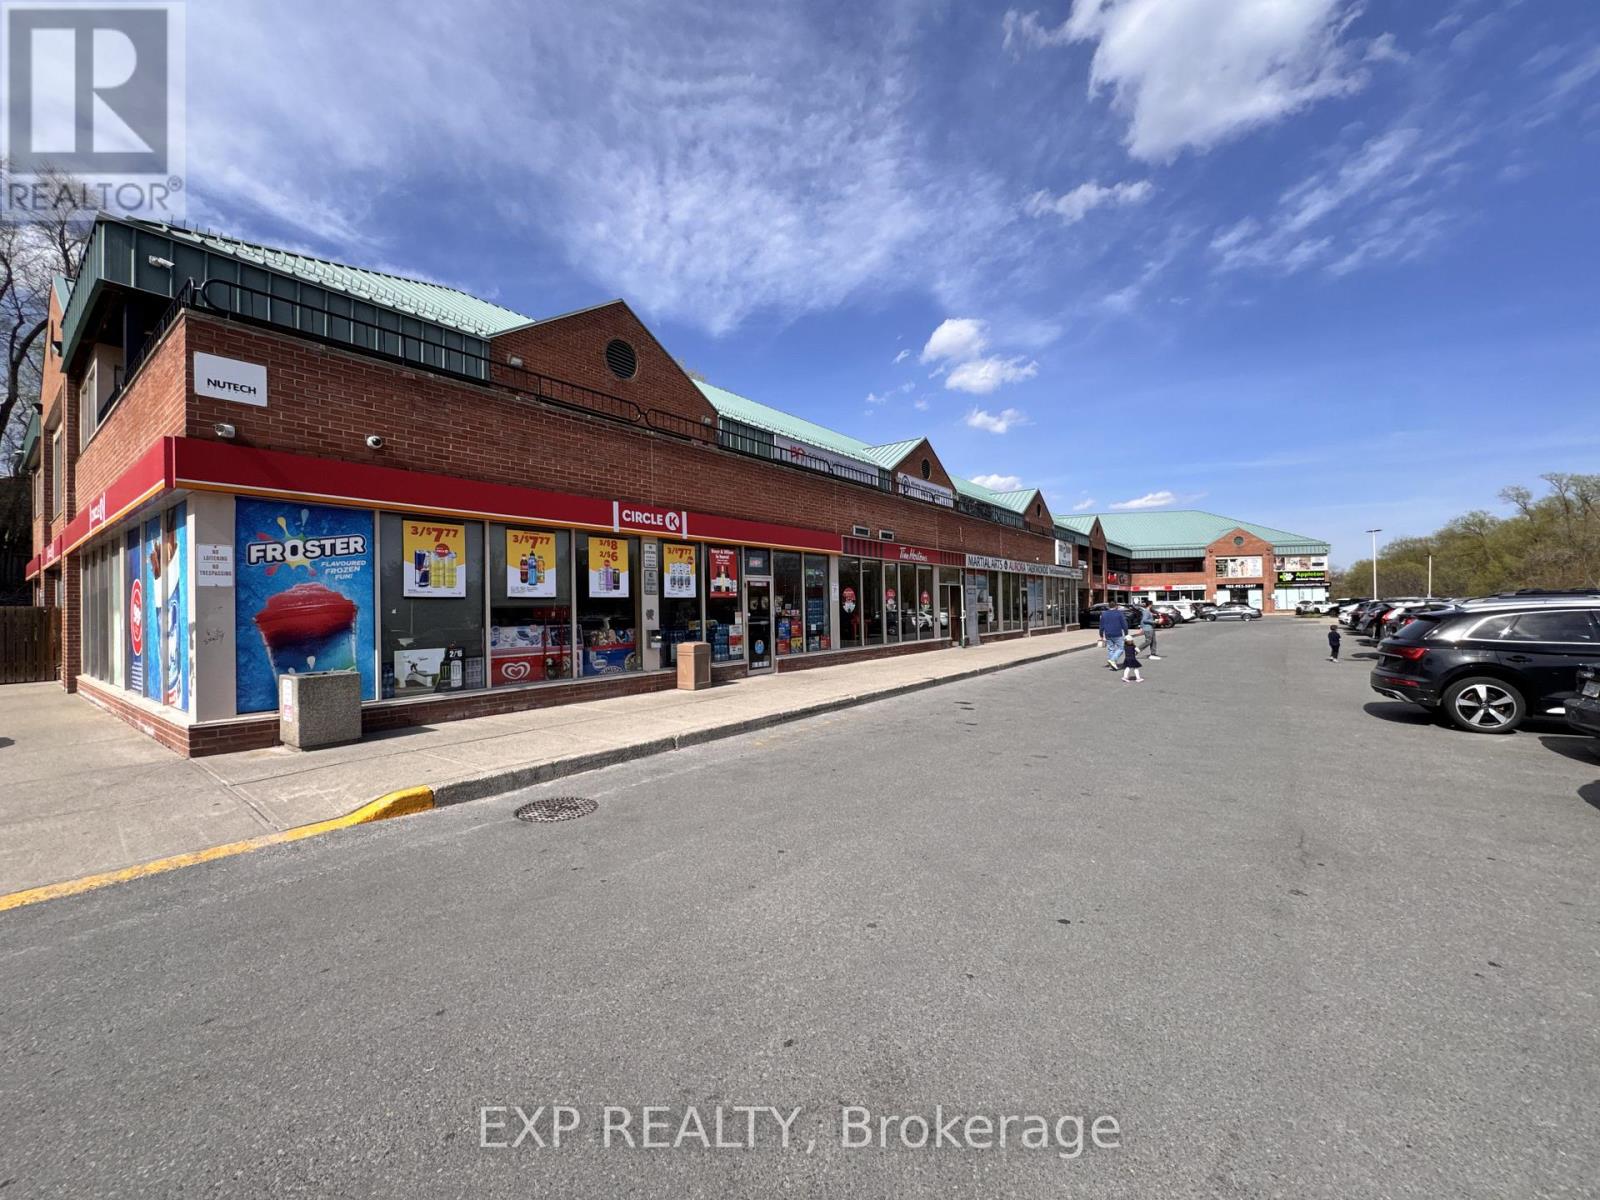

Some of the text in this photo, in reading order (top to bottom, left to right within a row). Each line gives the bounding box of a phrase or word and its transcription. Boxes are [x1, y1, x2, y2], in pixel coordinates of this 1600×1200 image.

[207, 378, 257, 395] NUTECH
[622, 509, 681, 531] CIRCLE K
[249, 536, 366, 564] FROSTER
[320, 559, 367, 568] FLAVOURED
[324, 566, 361, 575] FROZEN
[968, 555, 991, 569] MARTIAL
[991, 558, 1003, 570] ARTS
[1008, 561, 1025, 572] AURORA
[334, 573, 353, 581] FUN!
